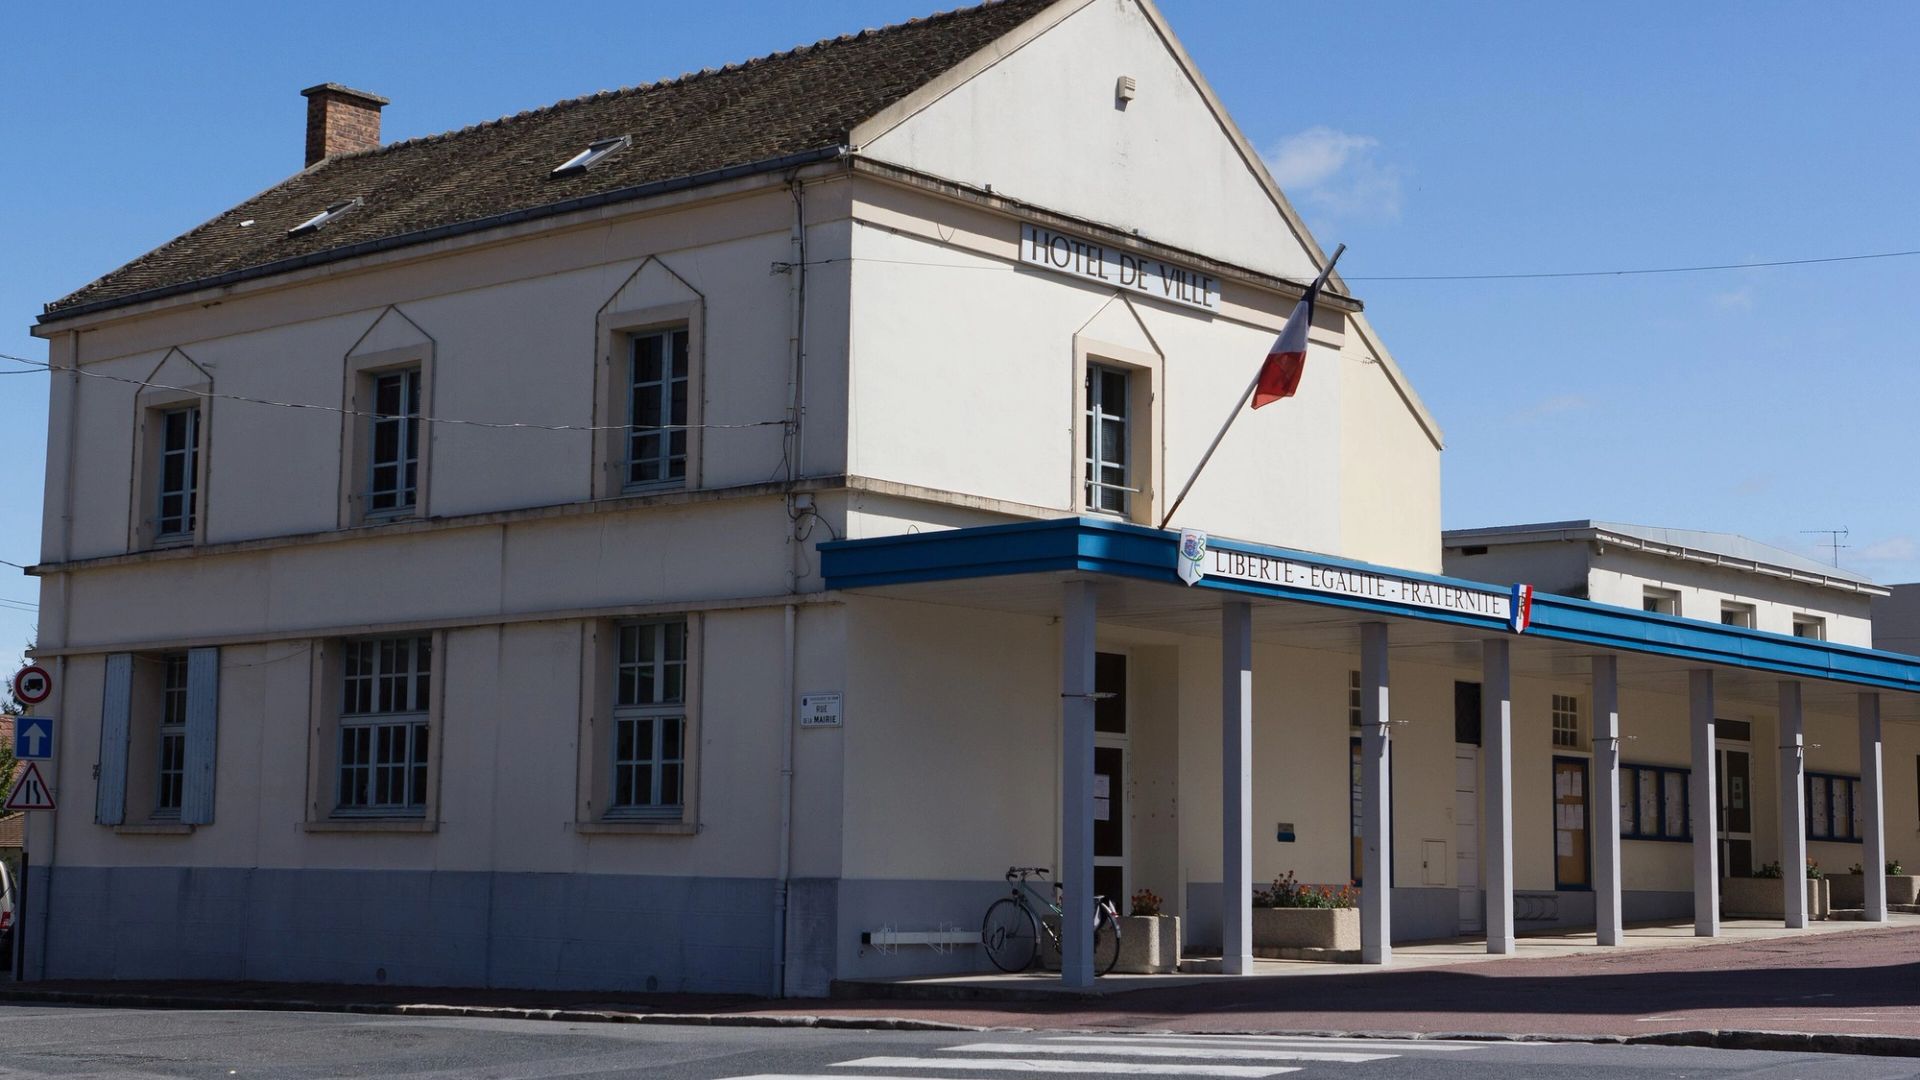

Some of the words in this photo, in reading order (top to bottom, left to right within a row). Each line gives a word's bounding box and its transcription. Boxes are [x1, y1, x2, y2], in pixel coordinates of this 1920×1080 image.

[1032, 228, 1108, 280] HOTEL
[1119, 253, 1148, 290] DE
[1159, 264, 1213, 308] VILLE
[1216, 550, 1294, 583] LIBERTE
[1311, 565, 1386, 597] EGALITE
[1401, 579, 1501, 615] FRATERNITE
[814, 715, 837, 724] MAIRIE
